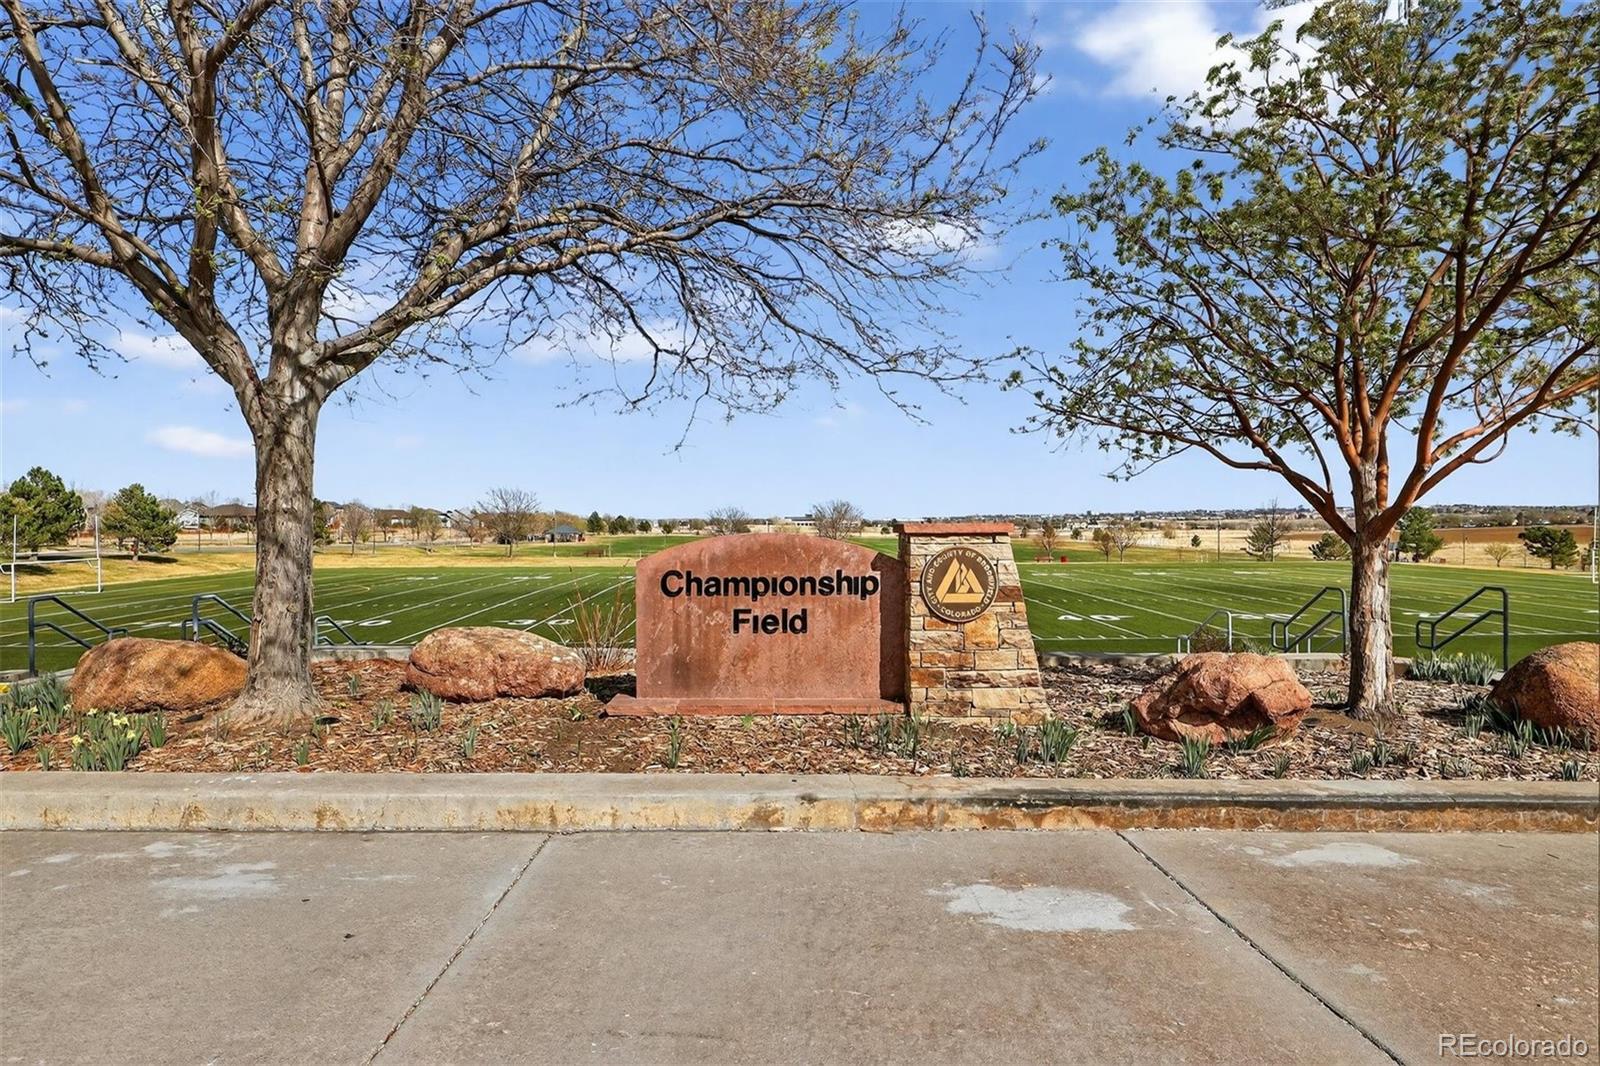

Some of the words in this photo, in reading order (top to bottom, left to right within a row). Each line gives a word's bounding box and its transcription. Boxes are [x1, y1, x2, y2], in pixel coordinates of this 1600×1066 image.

[926, 569, 935, 584] AND
[933, 549, 964, 568] COUNTY
[965, 550, 977, 559] OF
[660, 569, 879, 602] Championship
[733, 608, 808, 634] Field
[940, 606, 981, 618] COLORADO
